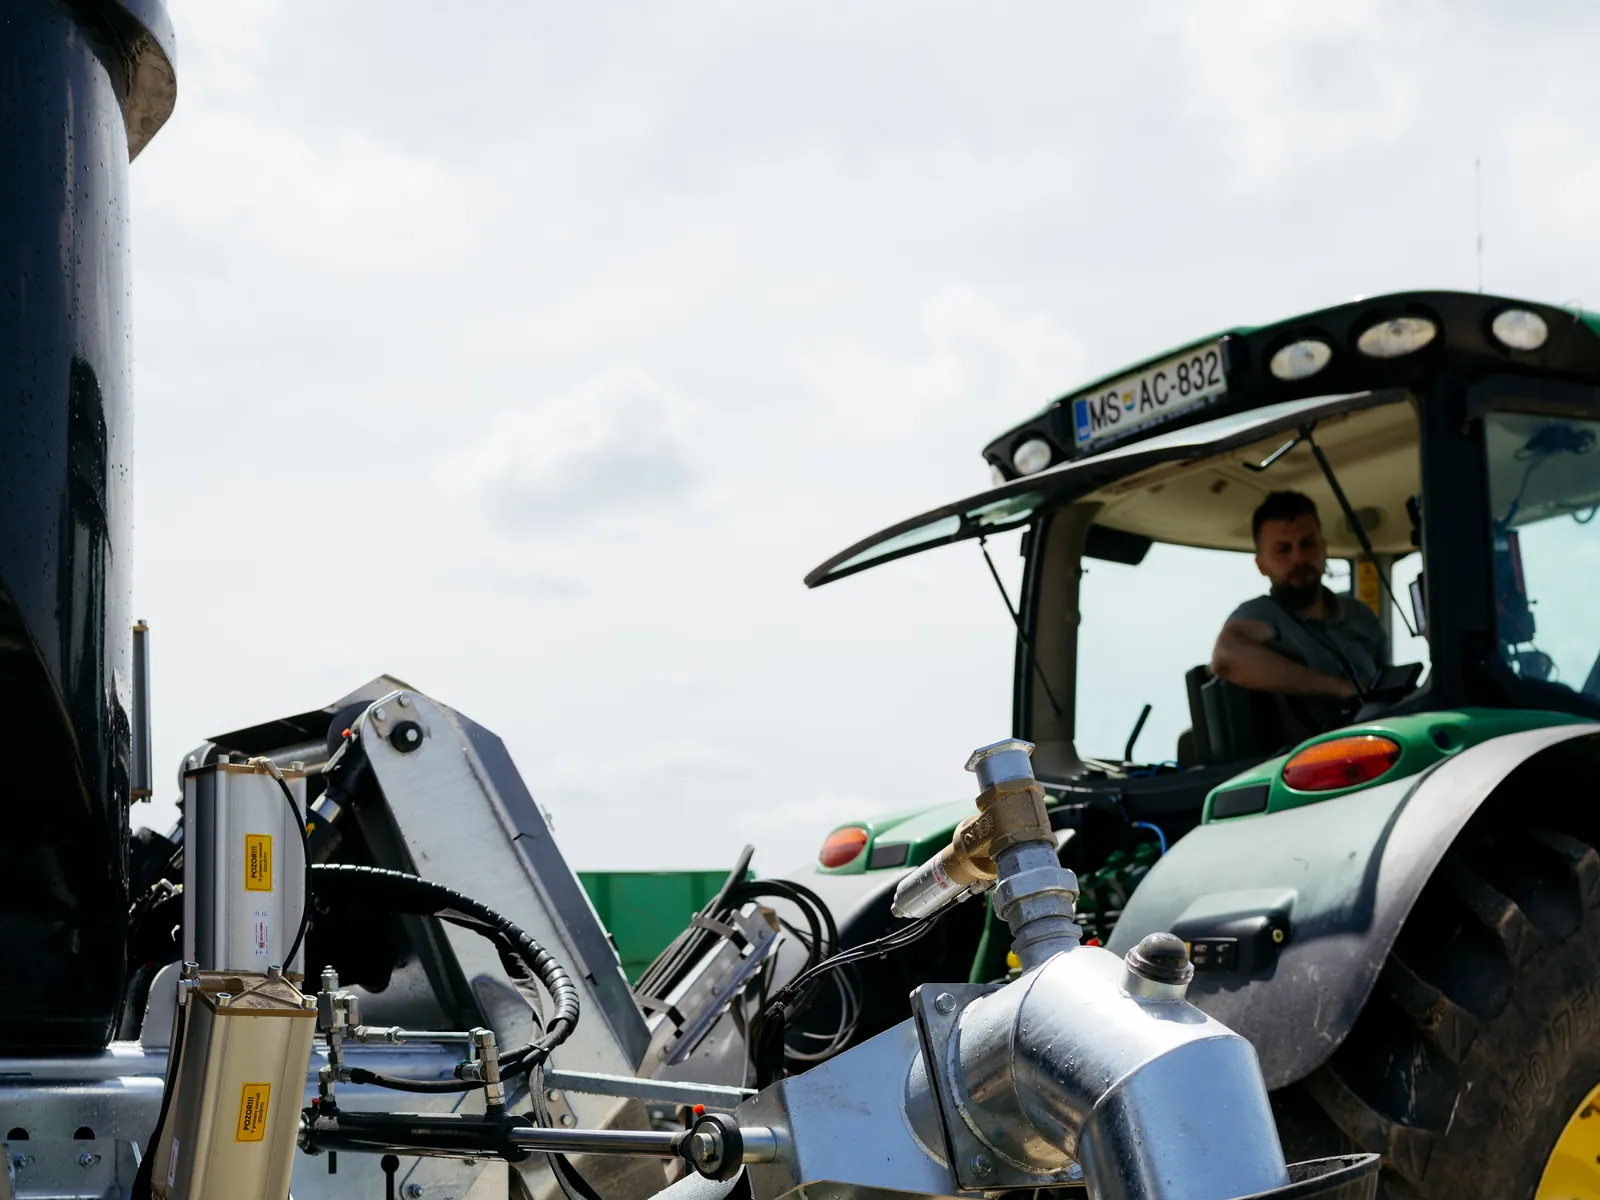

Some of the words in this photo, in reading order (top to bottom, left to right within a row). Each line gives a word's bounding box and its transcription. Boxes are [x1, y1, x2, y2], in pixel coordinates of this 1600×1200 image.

[1089, 391, 1121, 432] MS
[1139, 350, 1220, 415] AC-832
[244, 1096, 254, 1130] POZOR!!!
